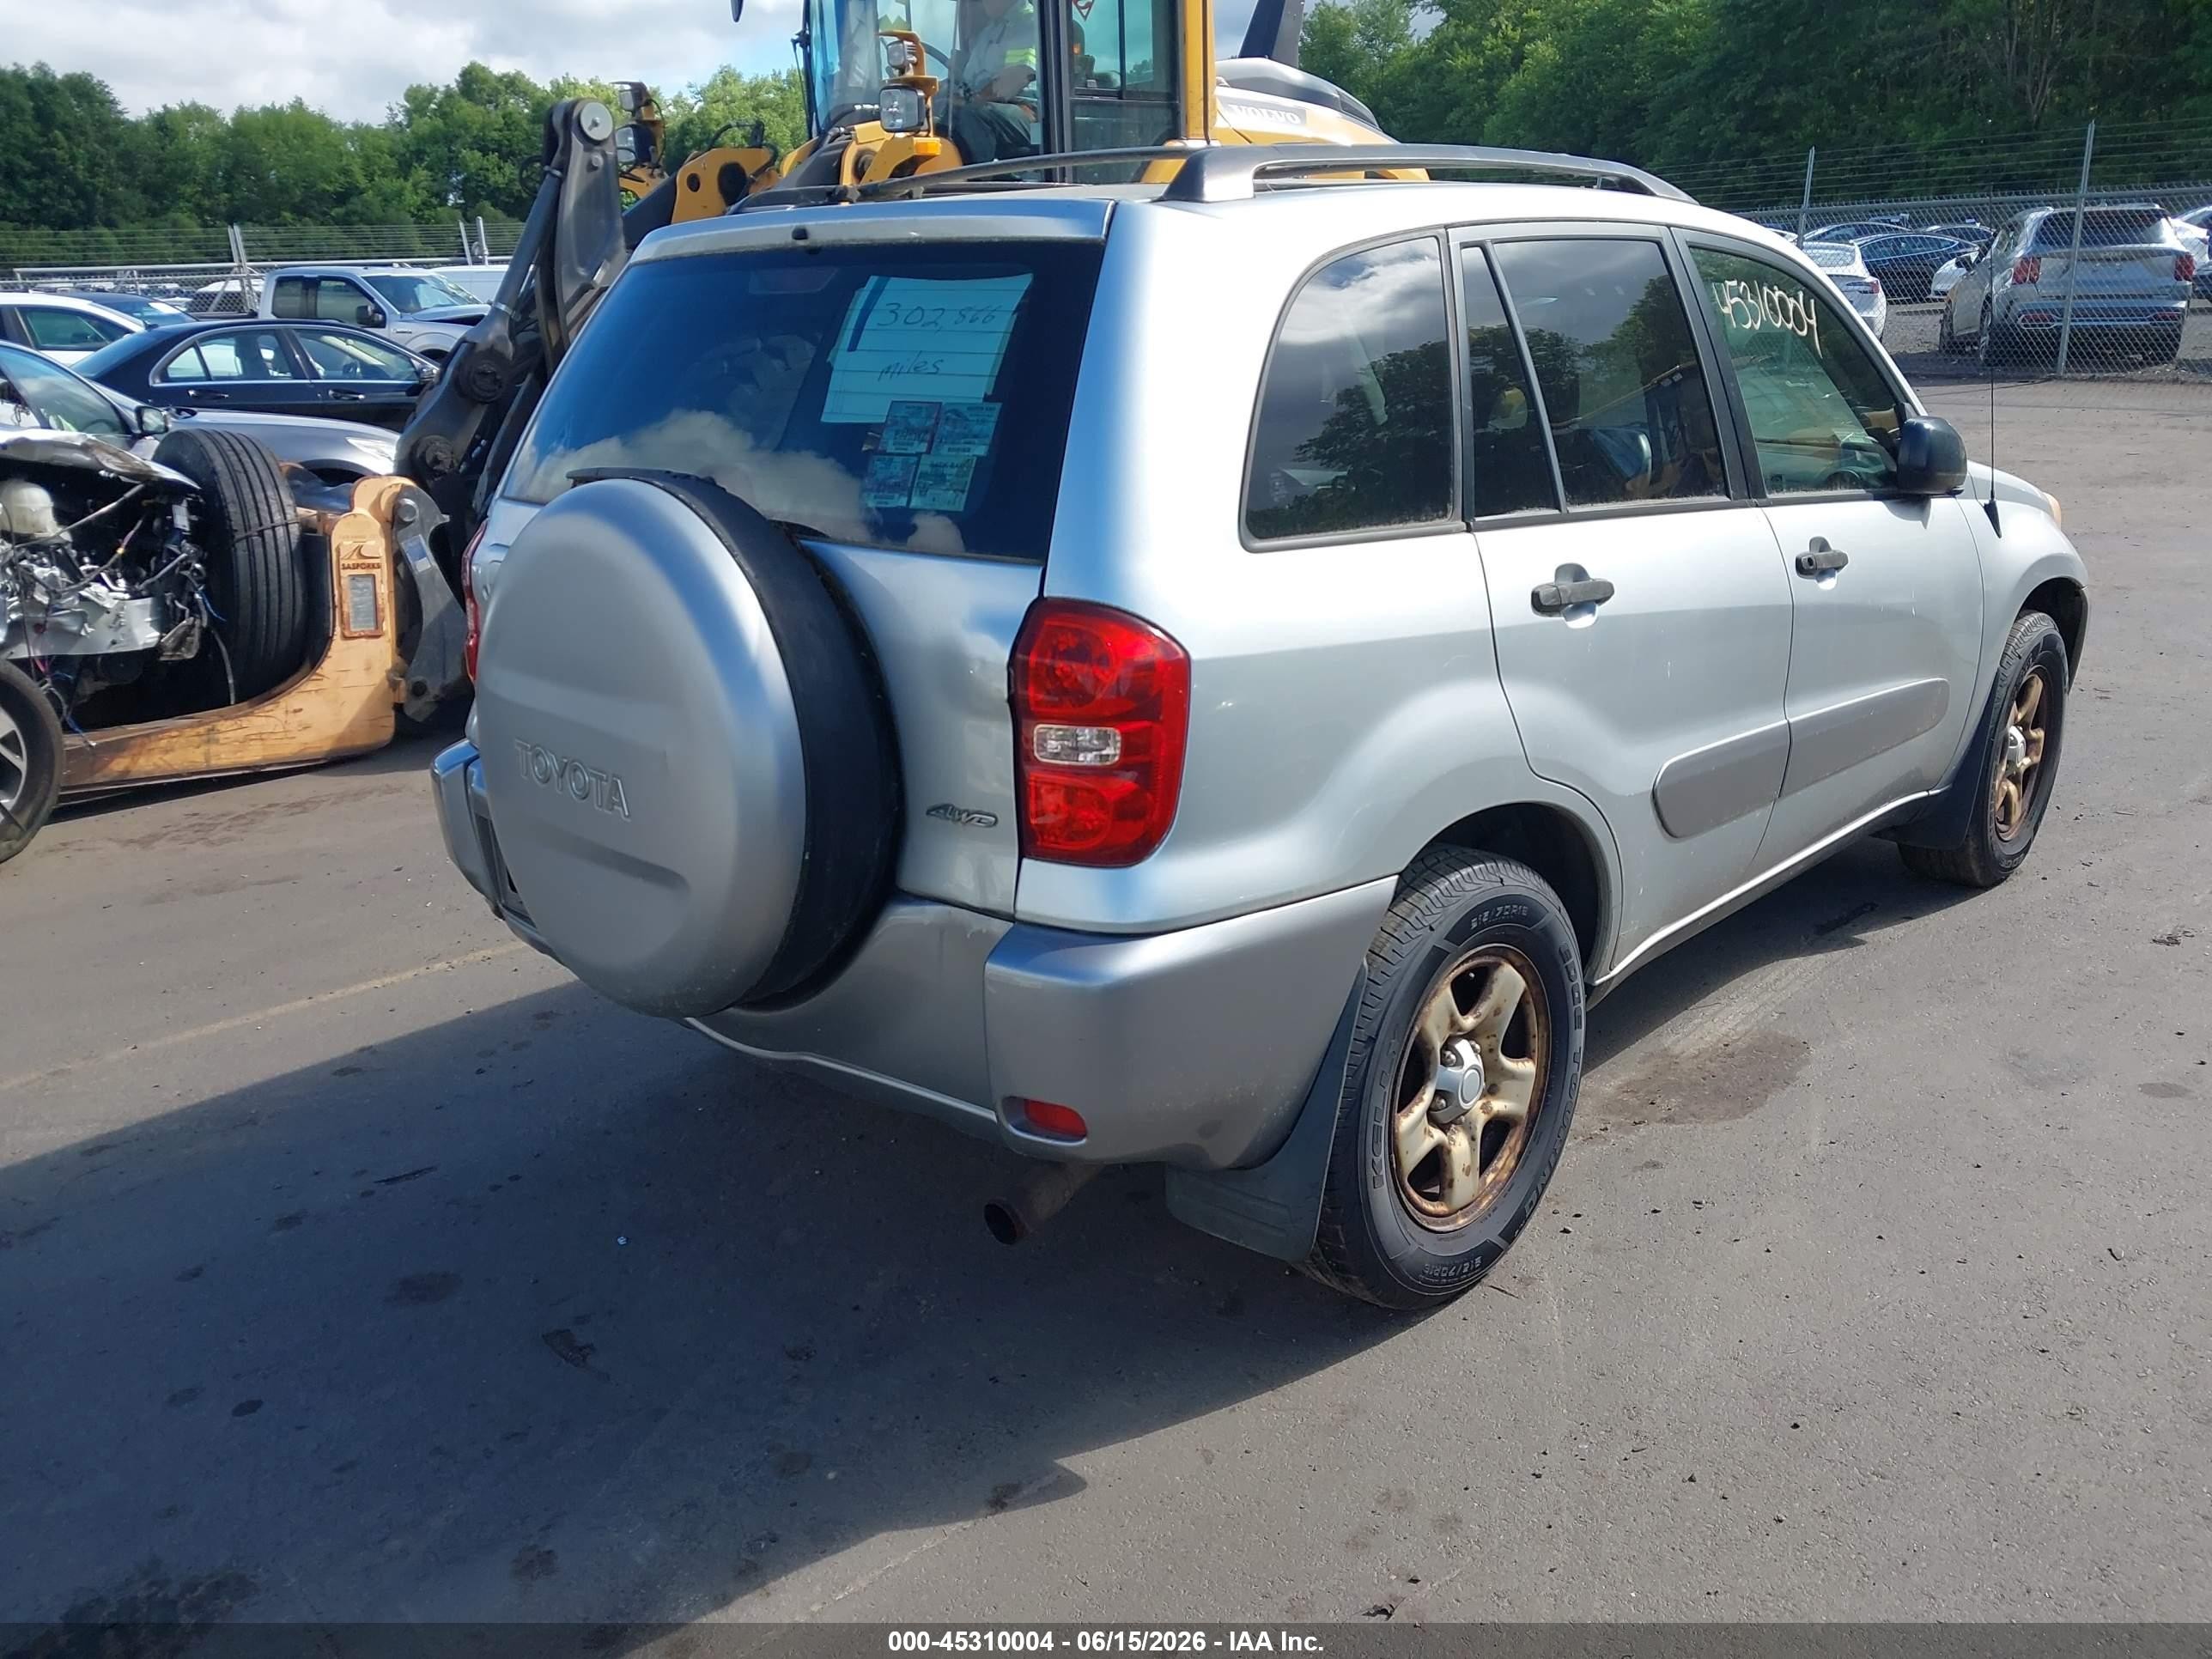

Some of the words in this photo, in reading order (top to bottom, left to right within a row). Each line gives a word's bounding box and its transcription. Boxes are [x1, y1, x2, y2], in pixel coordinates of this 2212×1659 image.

[1228, 103, 1302, 125] VOLVO
[1711, 279, 1823, 359] 45310004
[514, 738, 632, 823] TOYOTA
